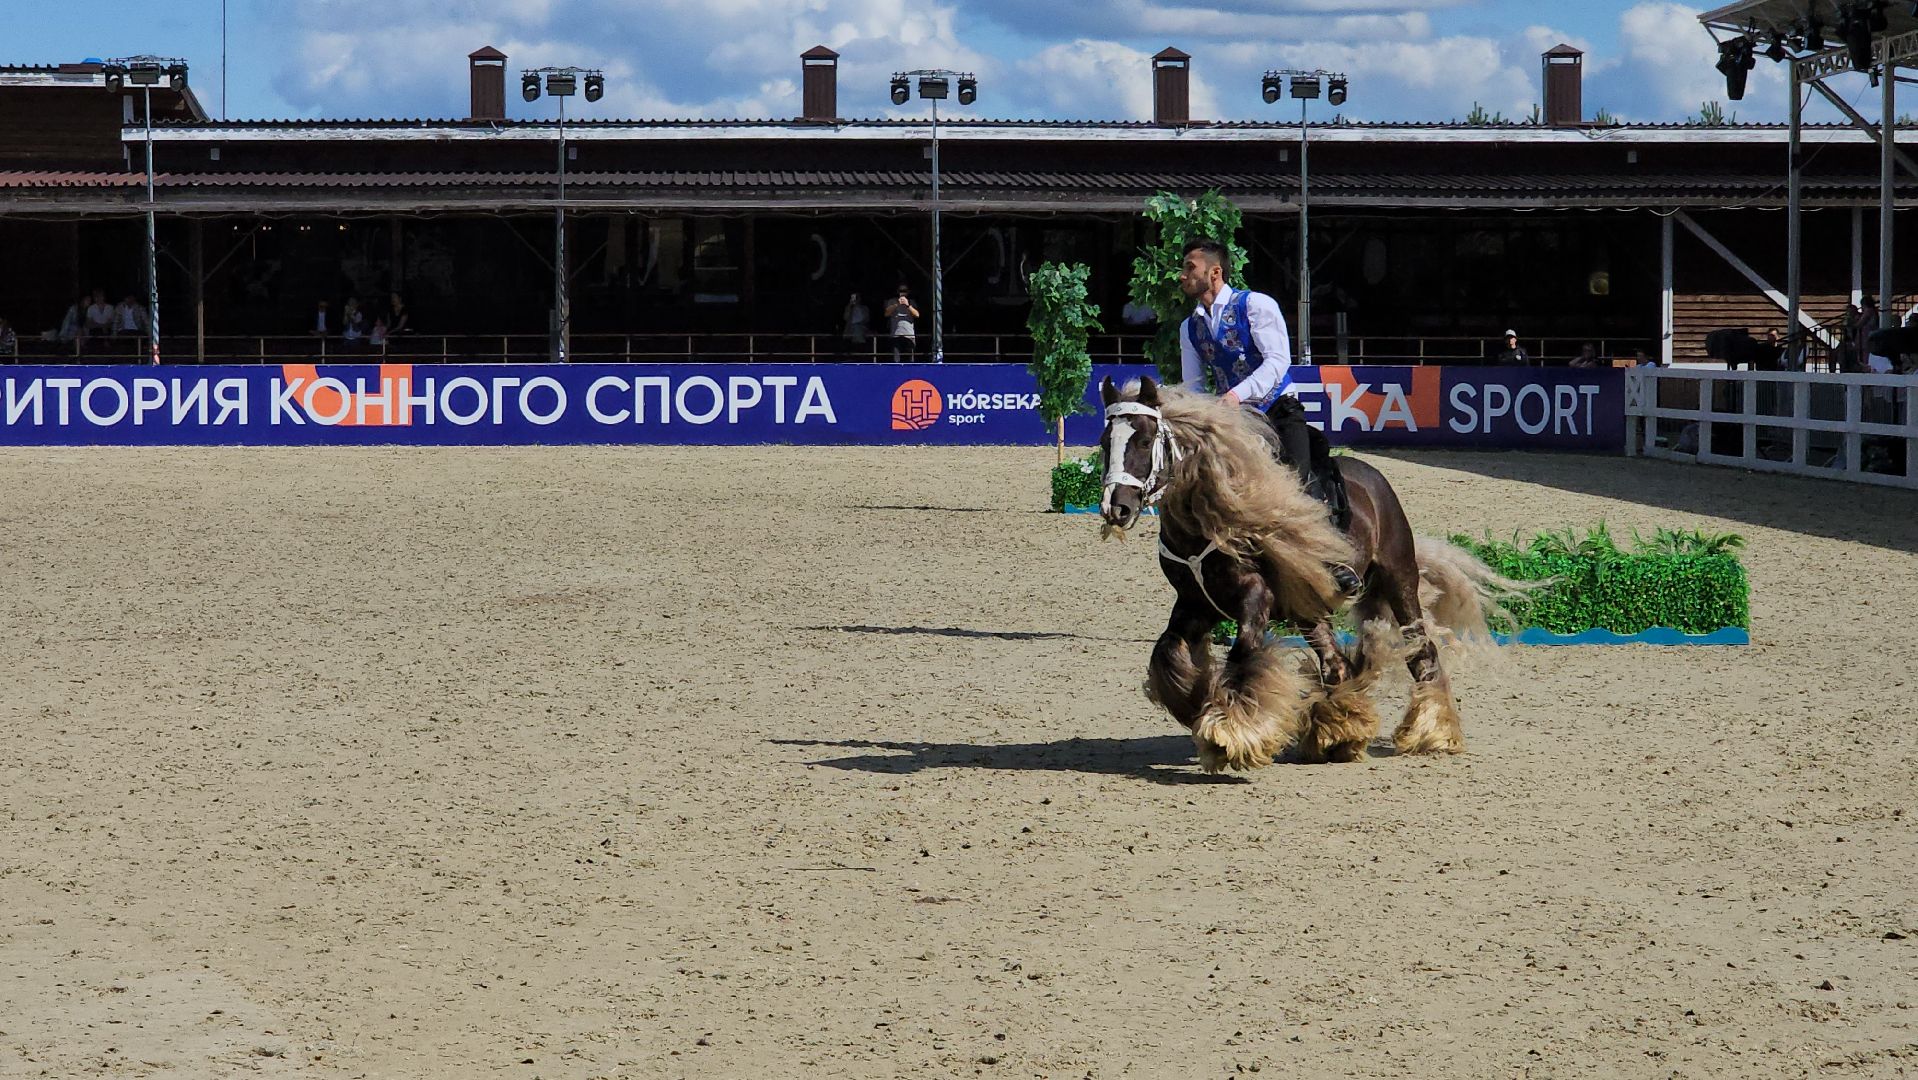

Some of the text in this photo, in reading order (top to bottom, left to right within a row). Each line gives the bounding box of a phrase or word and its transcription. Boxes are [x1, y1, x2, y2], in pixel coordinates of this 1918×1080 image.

[0, 376, 837, 426] ИТОРИЯ КОННОГО СПОРТА
[948, 413, 986, 426] sport
[1449, 382, 1600, 435] SPORT
